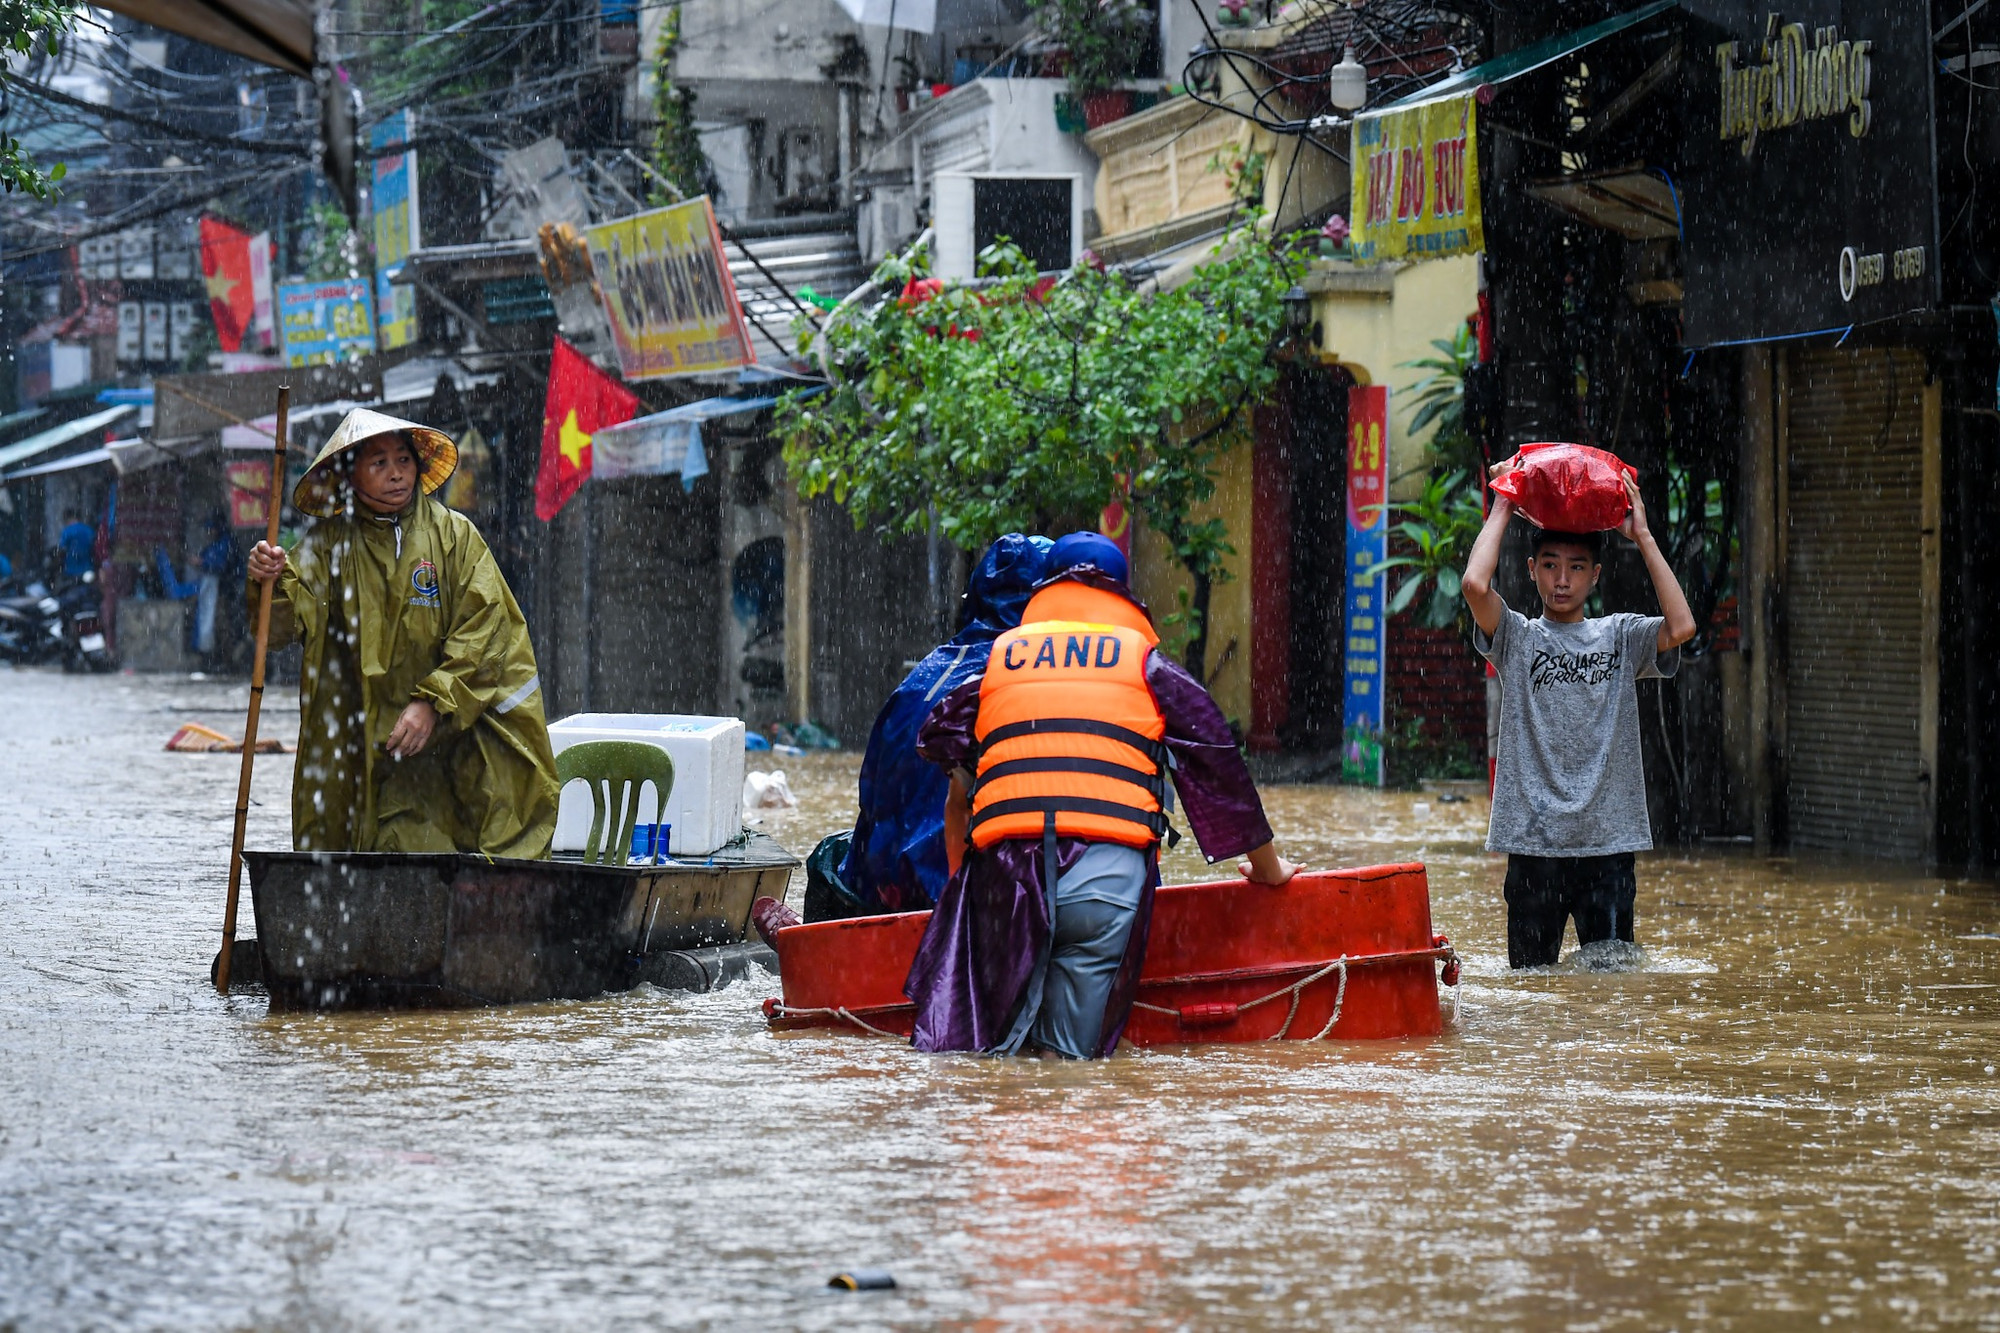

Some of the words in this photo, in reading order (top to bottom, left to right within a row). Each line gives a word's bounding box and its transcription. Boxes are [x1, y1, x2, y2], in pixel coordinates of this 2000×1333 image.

[1353, 421, 1380, 471] 2-9
[1004, 635, 1122, 670] CAND
[1532, 668, 1588, 694] HORROR
